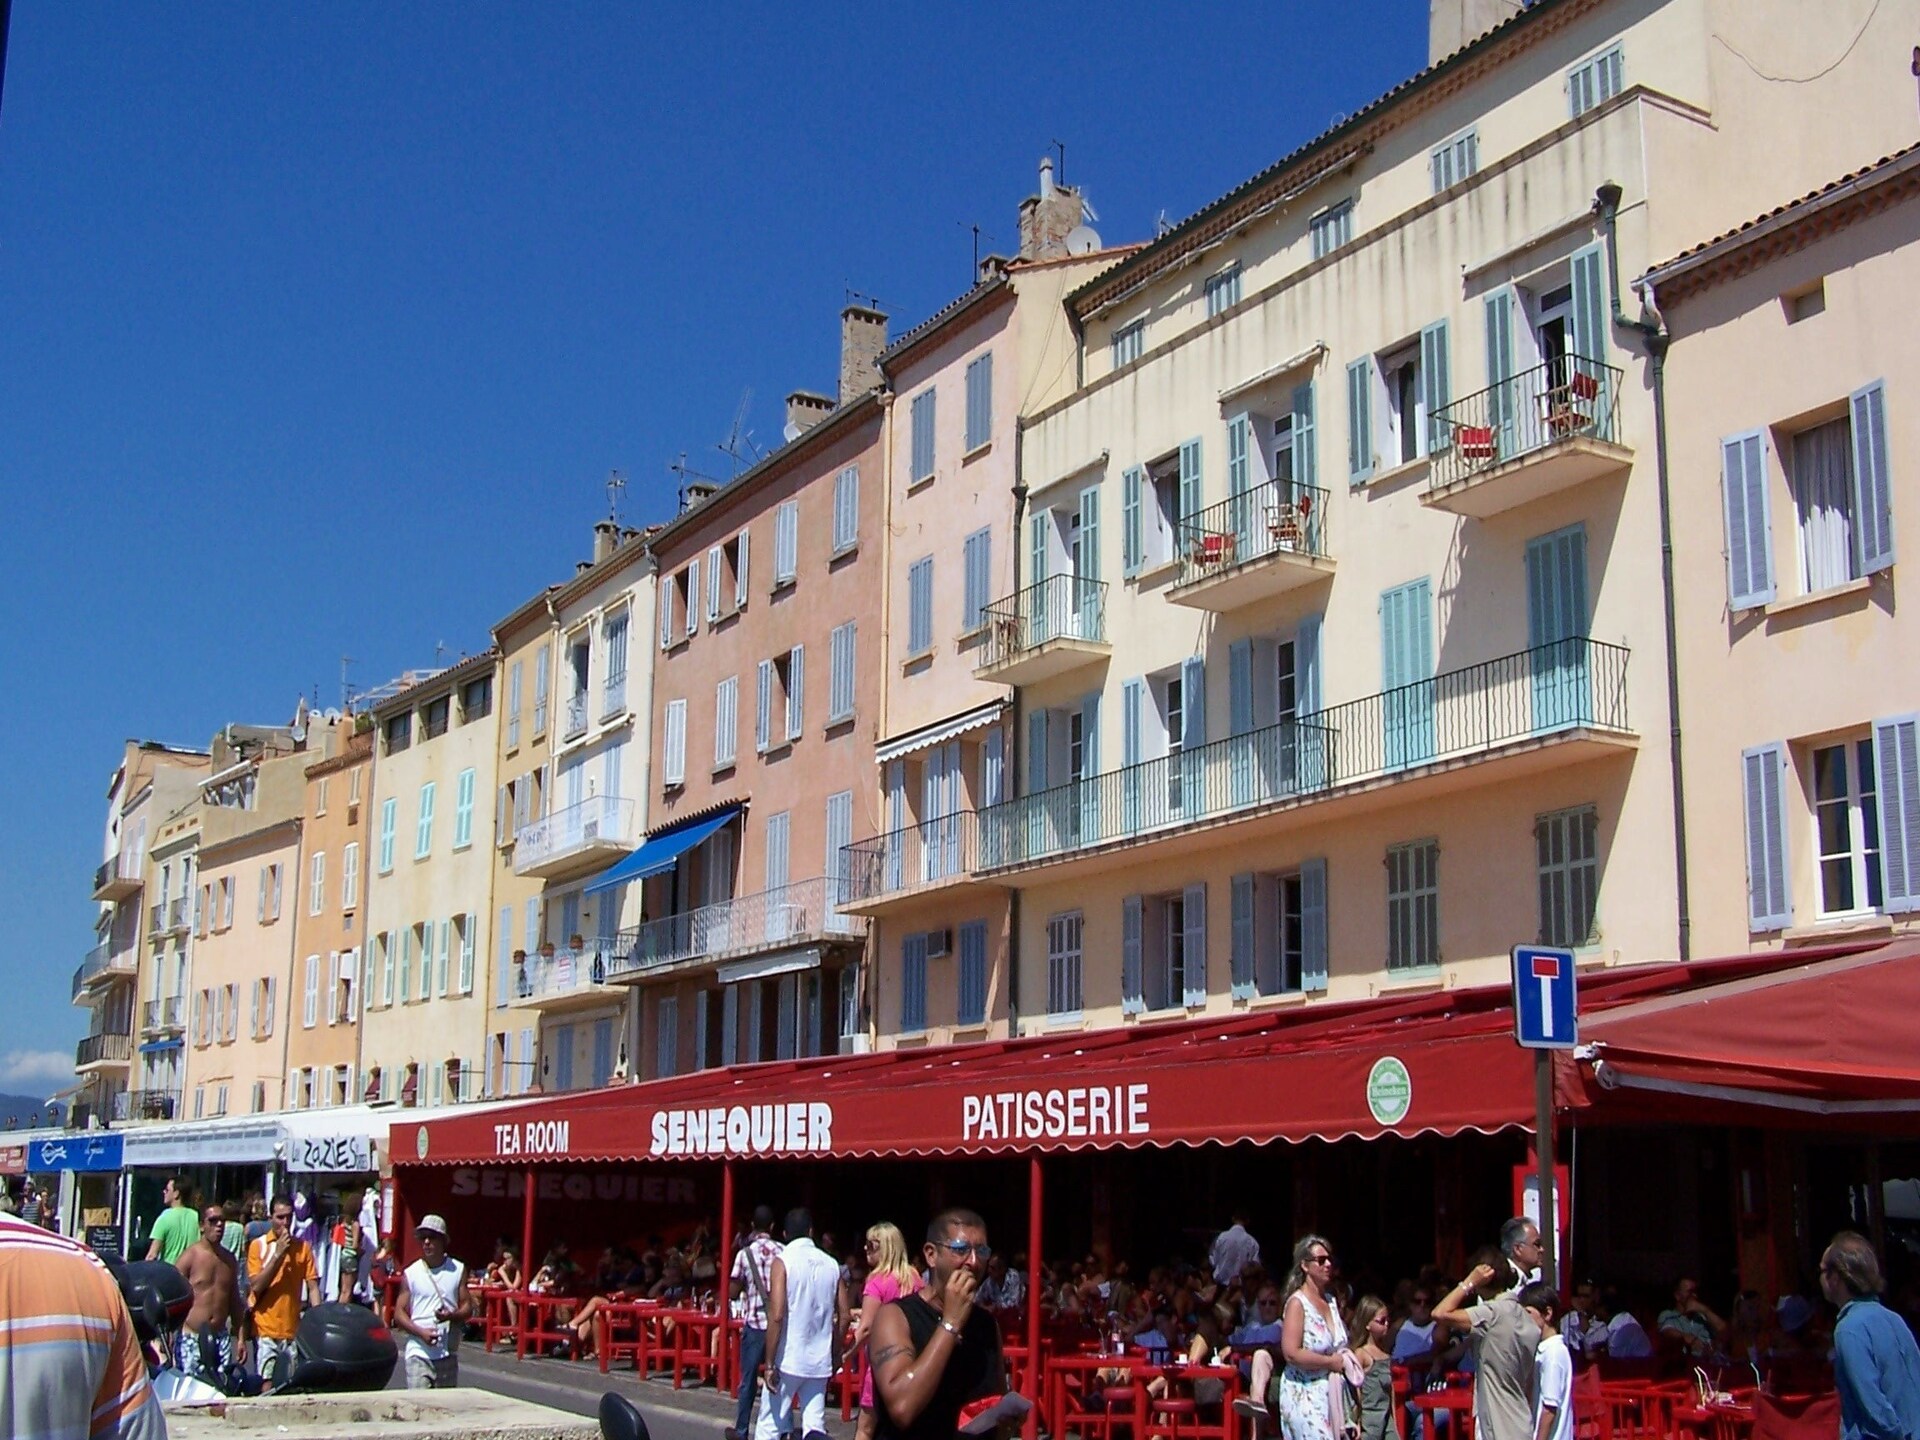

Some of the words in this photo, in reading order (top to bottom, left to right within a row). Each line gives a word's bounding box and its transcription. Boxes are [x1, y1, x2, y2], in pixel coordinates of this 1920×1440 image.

[650, 1102, 833, 1156] SENEQUIER
[963, 1083, 1150, 1140] PATISSERIE
[494, 1124, 521, 1156] TEA
[525, 1121, 569, 1154] ROOM
[450, 1168, 697, 1205] SENEQUIER
